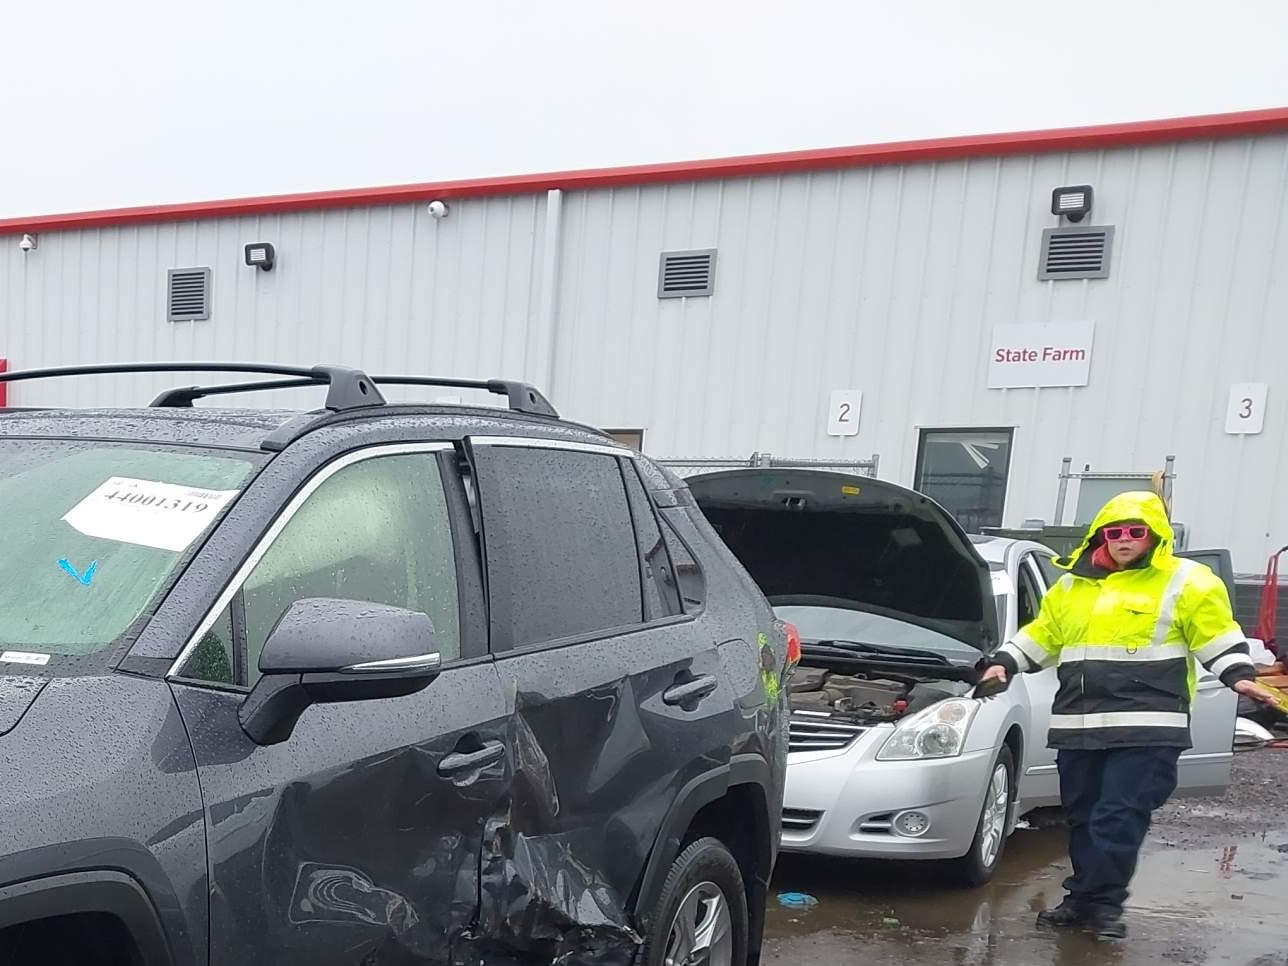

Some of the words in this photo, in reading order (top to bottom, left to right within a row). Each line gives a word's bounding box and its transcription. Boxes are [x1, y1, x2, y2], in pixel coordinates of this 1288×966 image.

[995, 347, 1038, 362] State
[1042, 347, 1085, 361] Farm
[838, 403, 850, 422] 2
[1239, 398, 1253, 418] 3
[105, 490, 209, 513] 44001319
